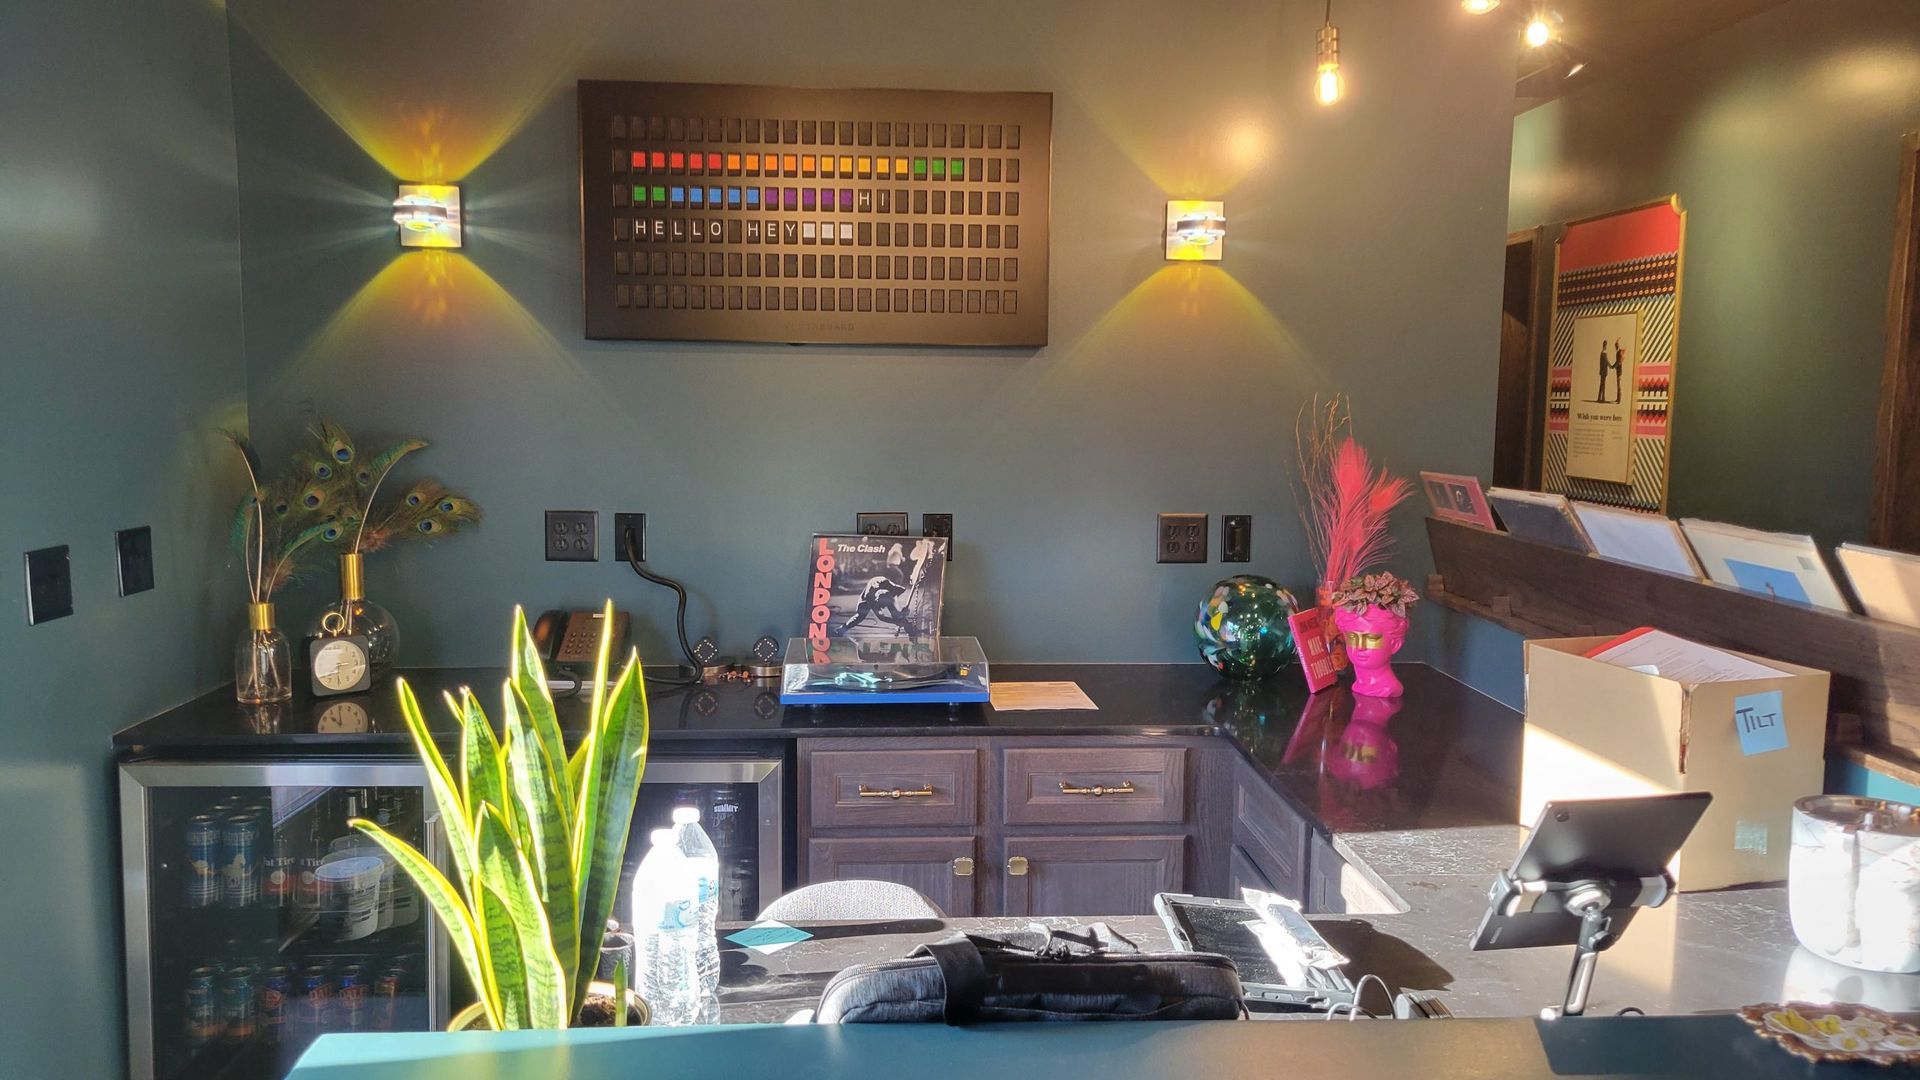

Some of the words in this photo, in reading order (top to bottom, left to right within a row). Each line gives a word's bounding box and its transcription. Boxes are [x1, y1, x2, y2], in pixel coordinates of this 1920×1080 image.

[858, 192, 886, 207] HI
[635, 220, 722, 236] HELLO
[747, 222, 796, 237] HEY
[837, 544, 856, 553] The
[857, 544, 886, 553] Clash
[809, 538, 835, 639] LONDON
[1735, 707, 1777, 733] TILT
[714, 804, 739, 812] SUMMIT
